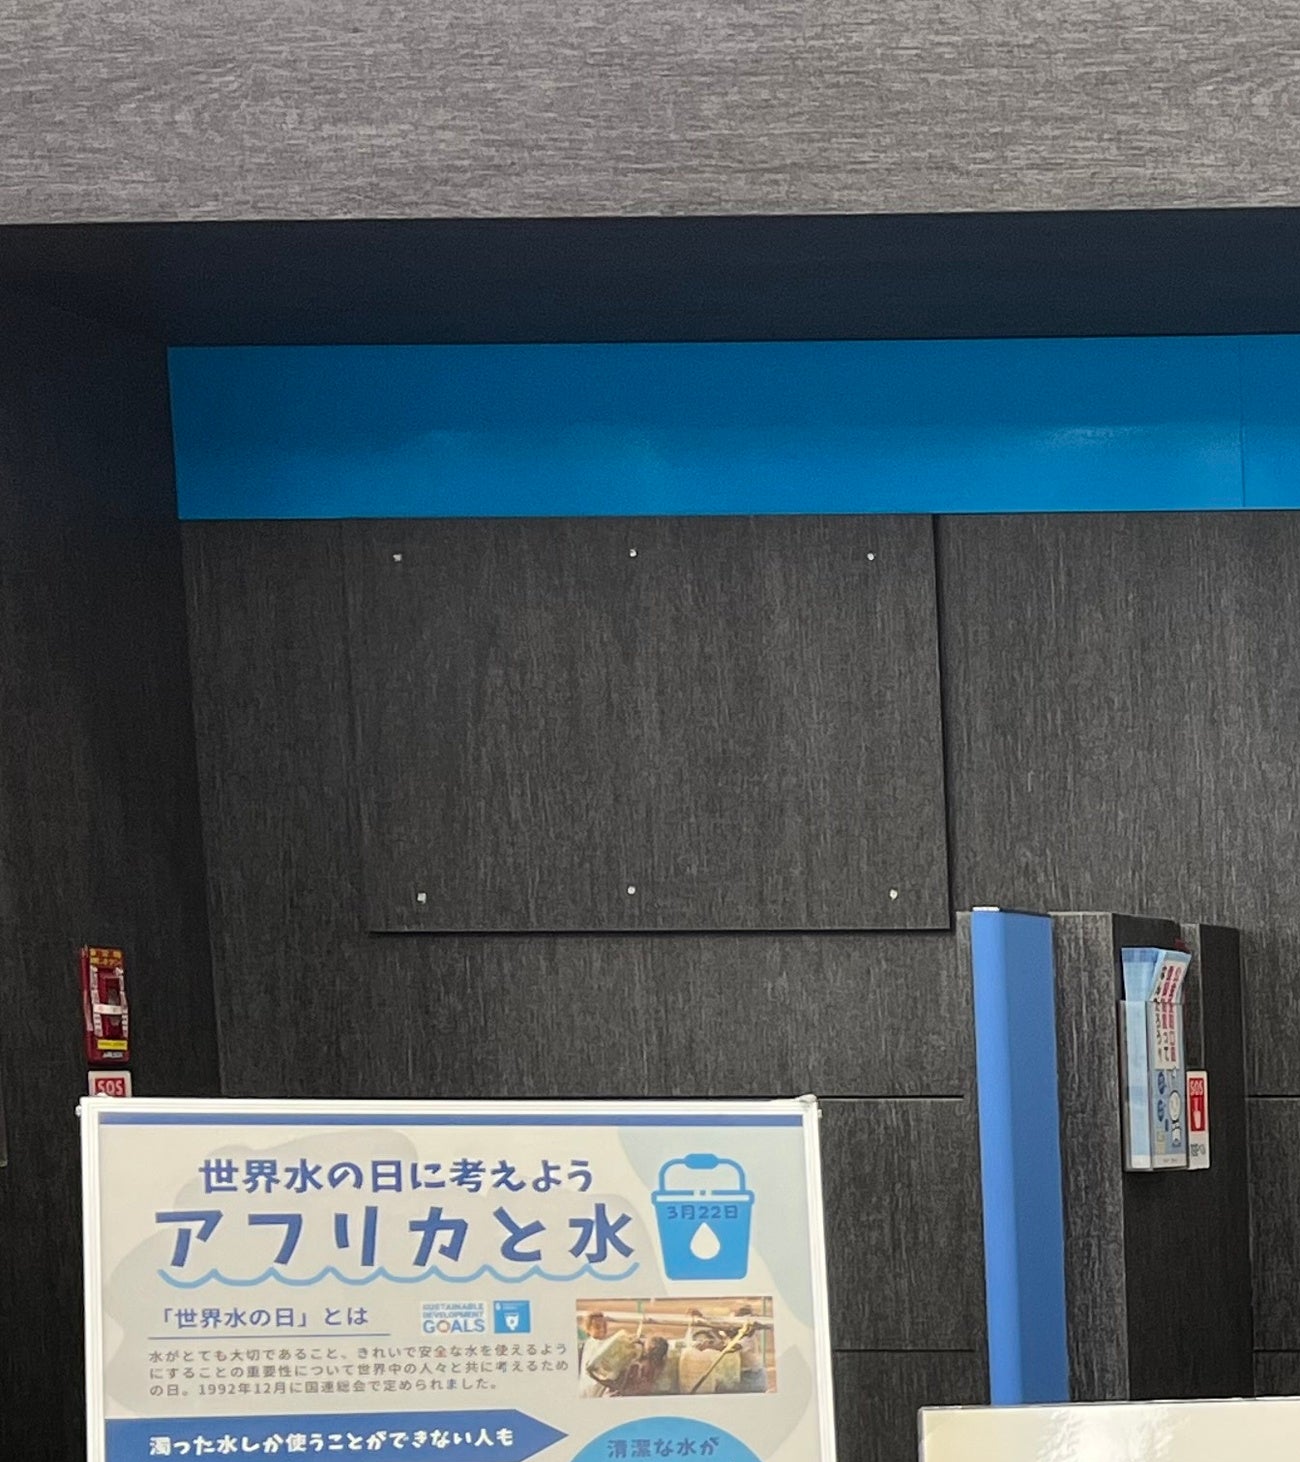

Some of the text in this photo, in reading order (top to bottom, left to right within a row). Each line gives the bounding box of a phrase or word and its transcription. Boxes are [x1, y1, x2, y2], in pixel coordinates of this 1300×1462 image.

[97, 1080, 123, 1096] SOS
[199, 1157, 594, 1195] 世界水の日に考えよう
[667, 1205, 738, 1220] 3月22日
[154, 1202, 636, 1268] アフリカと水
[160, 1306, 369, 1330] 「世界水の日」とは
[423, 1319, 485, 1333] GOALS
[149, 1343, 567, 1363] 水がとても大切であること、きれいで安全な水を使えるよう
[150, 1360, 568, 1379] にすることの重要性について世界中の人々と共に考えるため
[150, 1376, 499, 1396] の日。1992年12月に国連総会で定められました。
[149, 1428, 513, 1456] 濁った水しか使うことができない人も
[607, 1436, 720, 1459] 清潔な水が
